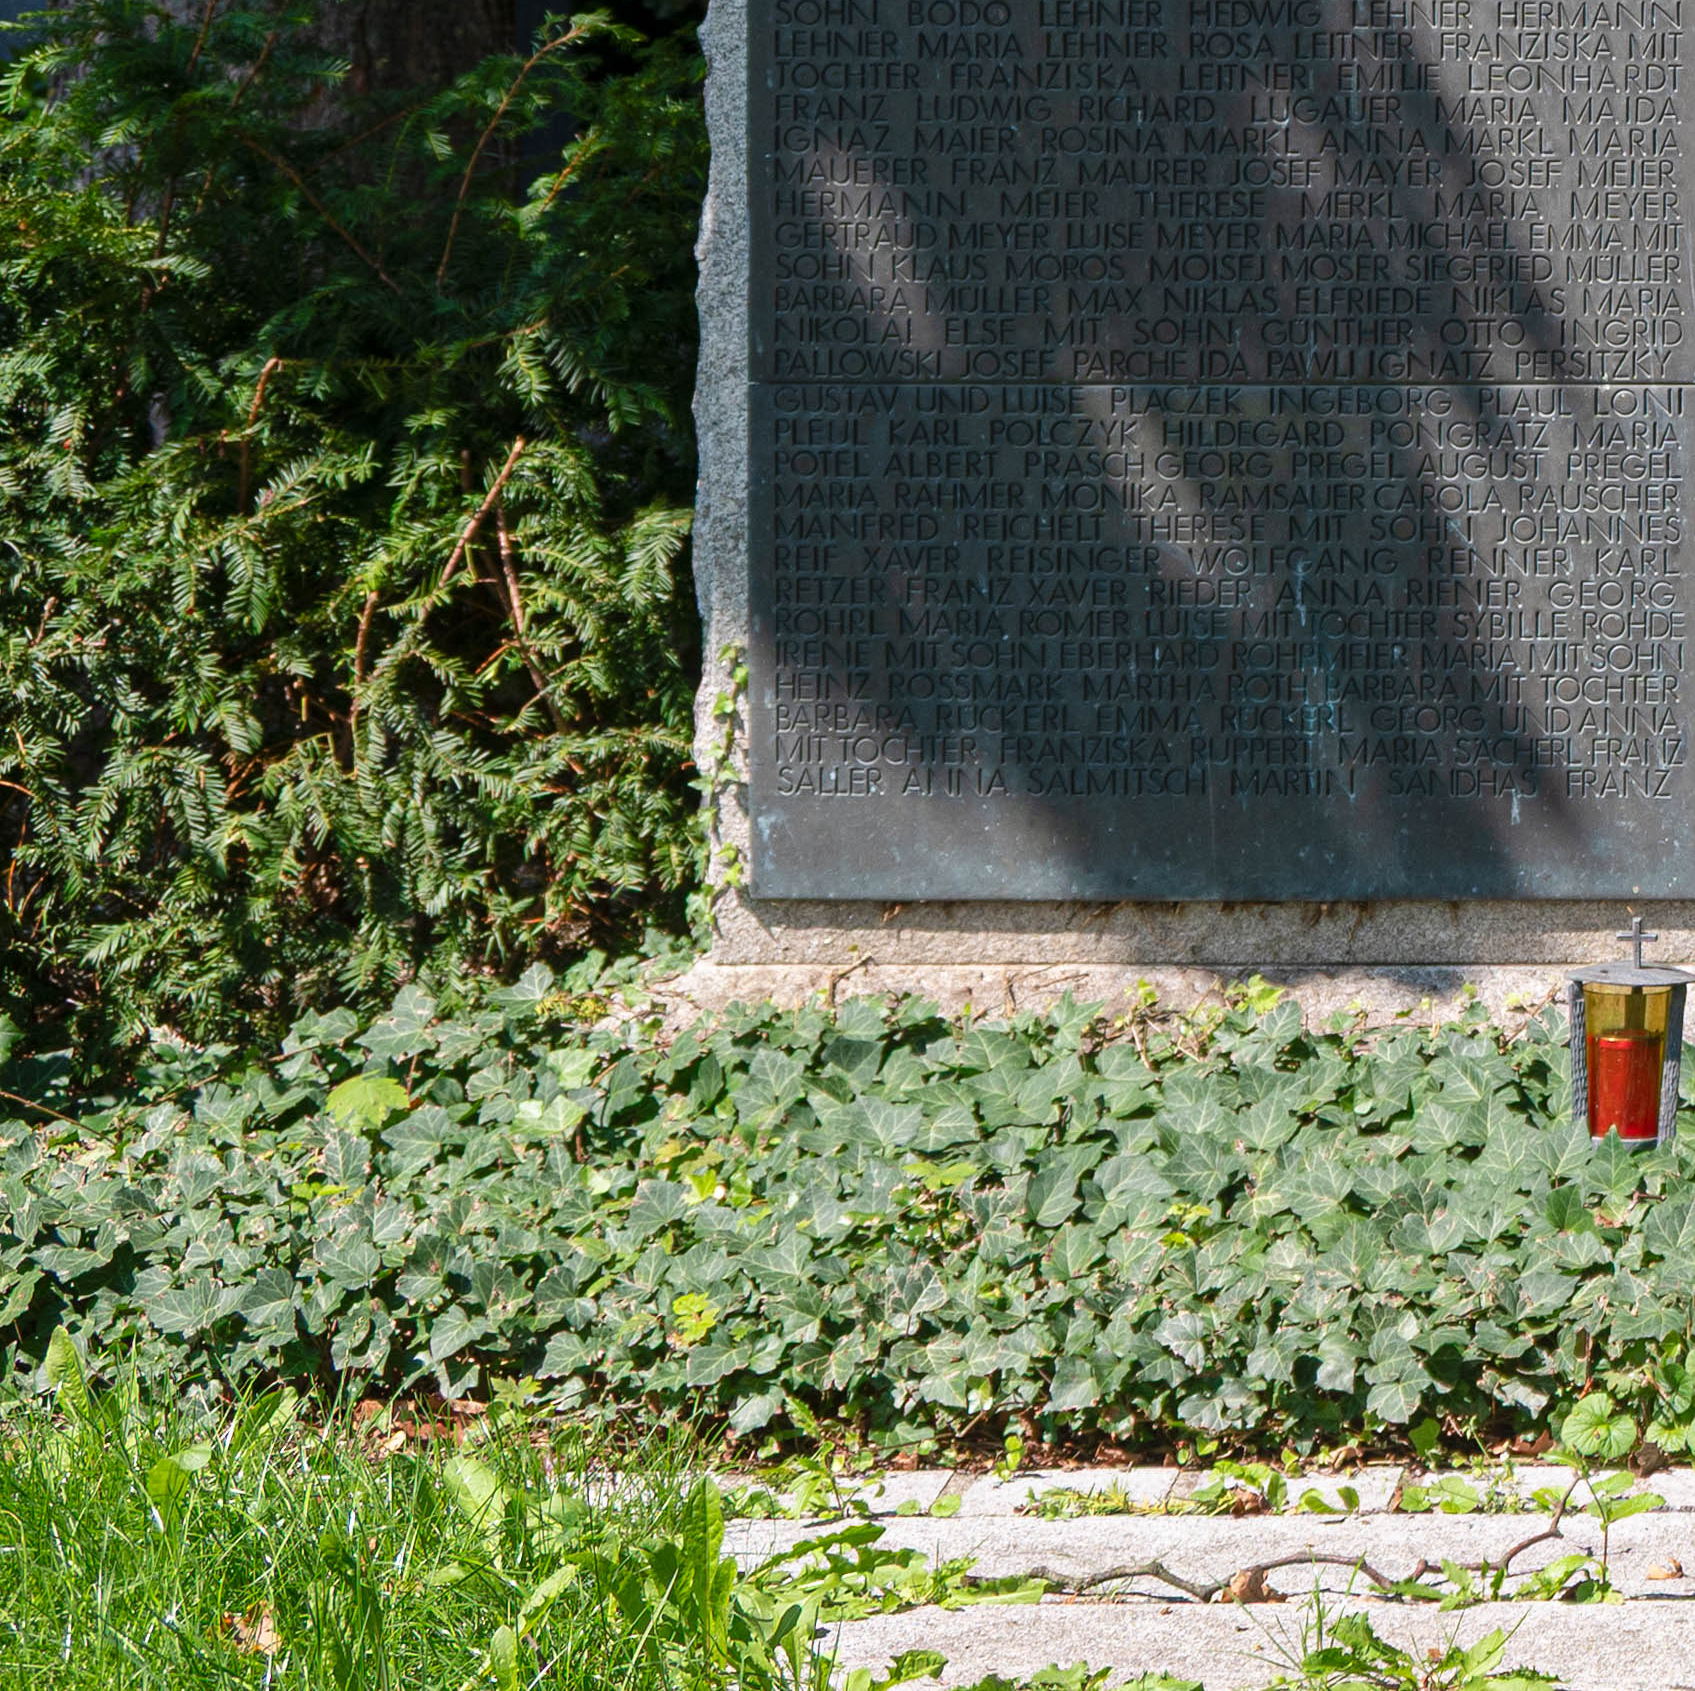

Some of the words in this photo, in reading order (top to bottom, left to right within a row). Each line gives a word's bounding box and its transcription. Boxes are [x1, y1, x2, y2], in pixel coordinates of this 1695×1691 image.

[1188, 0, 1322, 28] HEDWIG
[1350, 0, 1473, 29] LEHNER
[1496, 0, 1683, 29] HERMANN
[773, 93, 890, 124] FRANZ
[916, 94, 1052, 124] LUDWIG
[1076, 94, 1216, 125] RICHARD
[1249, 95, 1402, 125] LUGAUER
[1433, 95, 1541, 125] MARIA
[773, 386, 900, 415] GUSTAV
[913, 386, 990, 416] UND
[1000, 386, 1087, 416] LUISE
[1110, 386, 1243, 416] PLACZEK
[1268, 386, 1453, 416] INGEBORG
[1478, 386, 1573, 417] PLAUL
[1593, 386, 1684, 417] LONI
[776, 767, 885, 797] SALLER
[901, 767, 1009, 797] ANNA
[1228, 767, 1355, 798] MARTIN
[1386, 768, 1537, 798] SANDHAS
[1564, 768, 1673, 799] FRANZ
